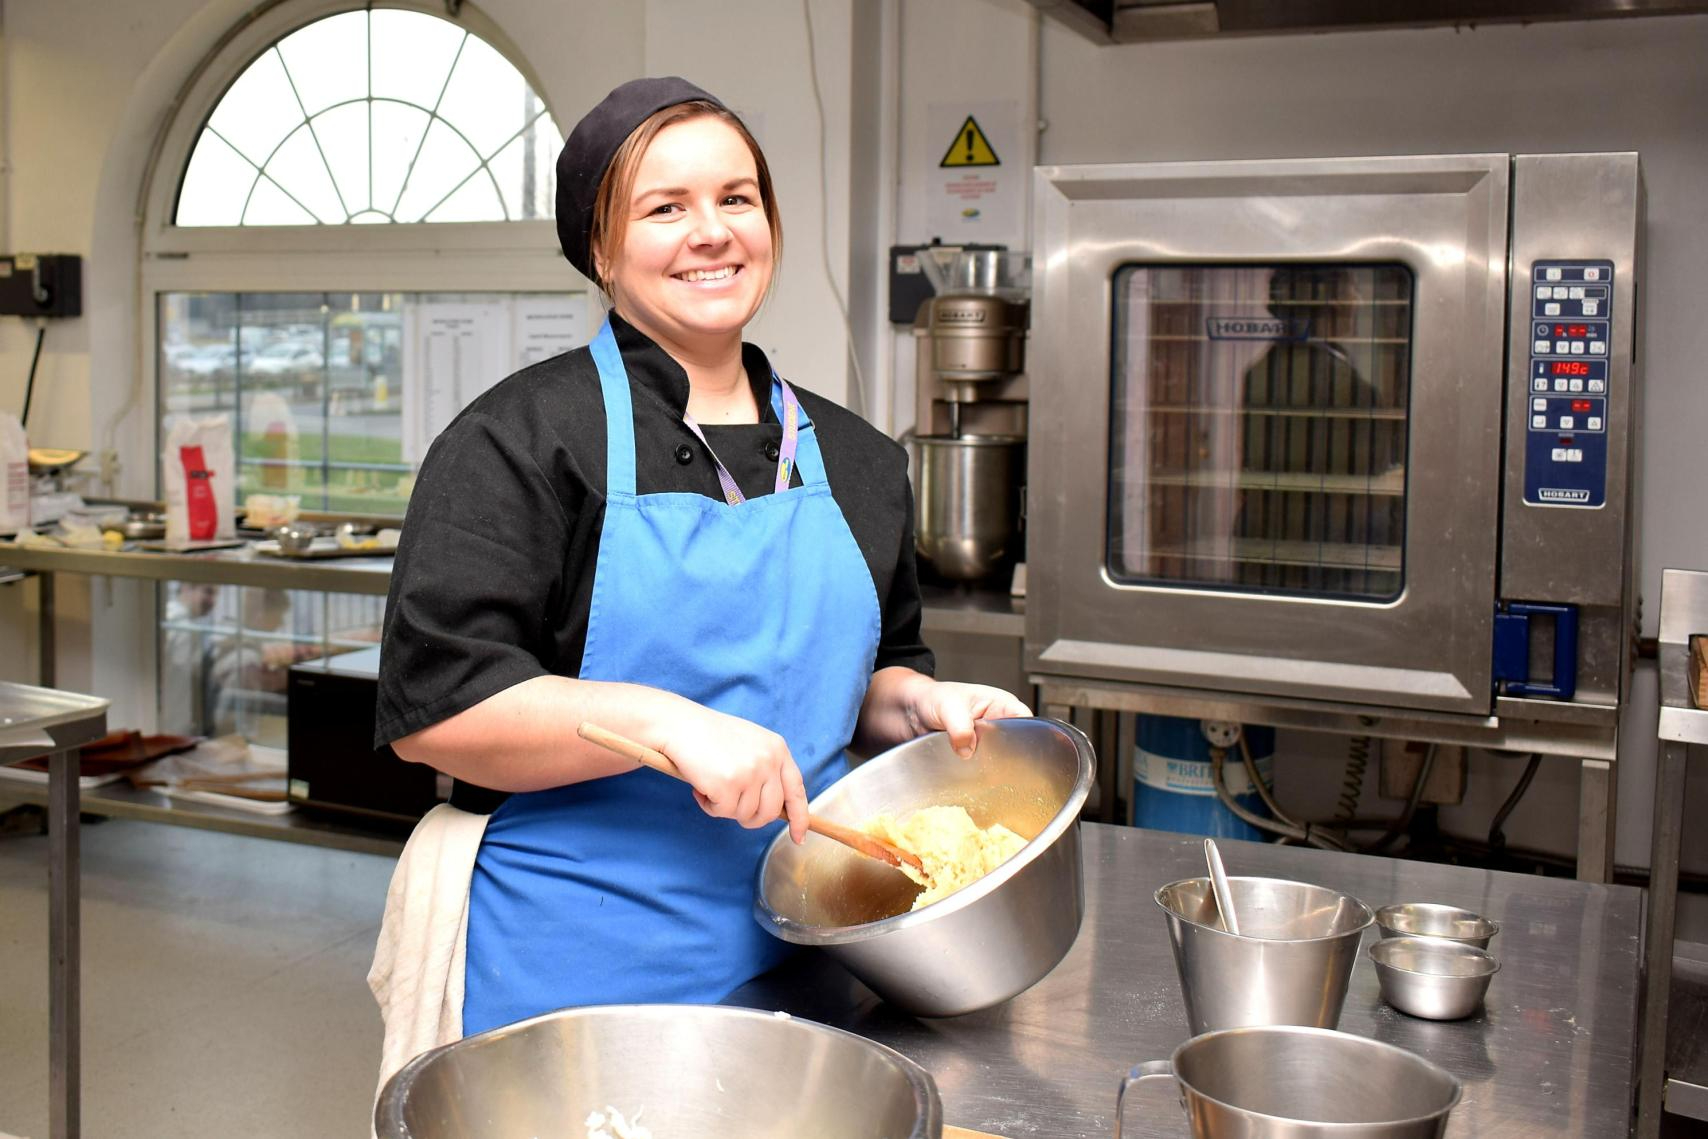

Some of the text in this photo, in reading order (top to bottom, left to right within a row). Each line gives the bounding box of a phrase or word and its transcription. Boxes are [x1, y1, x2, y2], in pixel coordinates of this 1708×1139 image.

[1216, 321, 1298, 334] HOBAR
[1543, 490, 1586, 500] HOBART
[1178, 762, 1214, 778] BRIT
